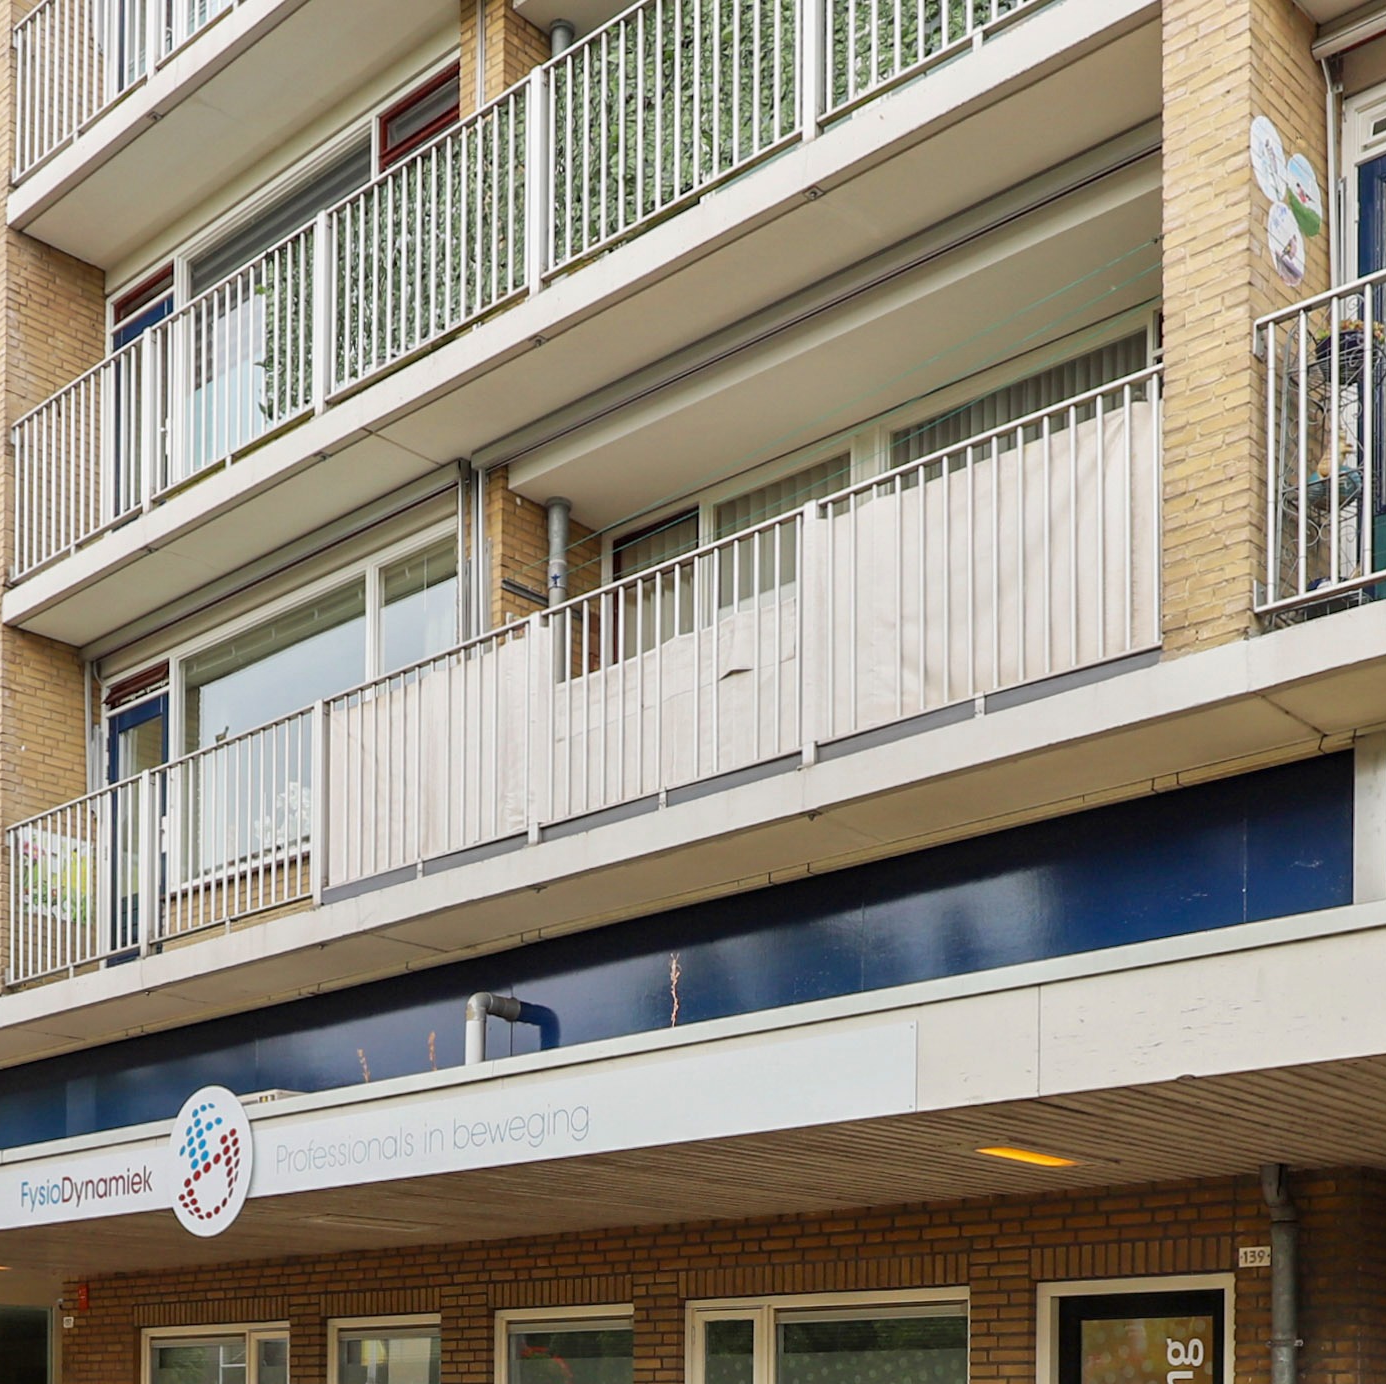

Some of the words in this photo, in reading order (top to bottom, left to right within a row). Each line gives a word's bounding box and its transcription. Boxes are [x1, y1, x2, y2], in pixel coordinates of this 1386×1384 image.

[275, 1127, 414, 1174] Professionals
[423, 1122, 444, 1155] in
[452, 1103, 590, 1149] beweging
[20, 1165, 153, 1213] FysioDynamiek
[1243, 1249, 1266, 1265] 139
